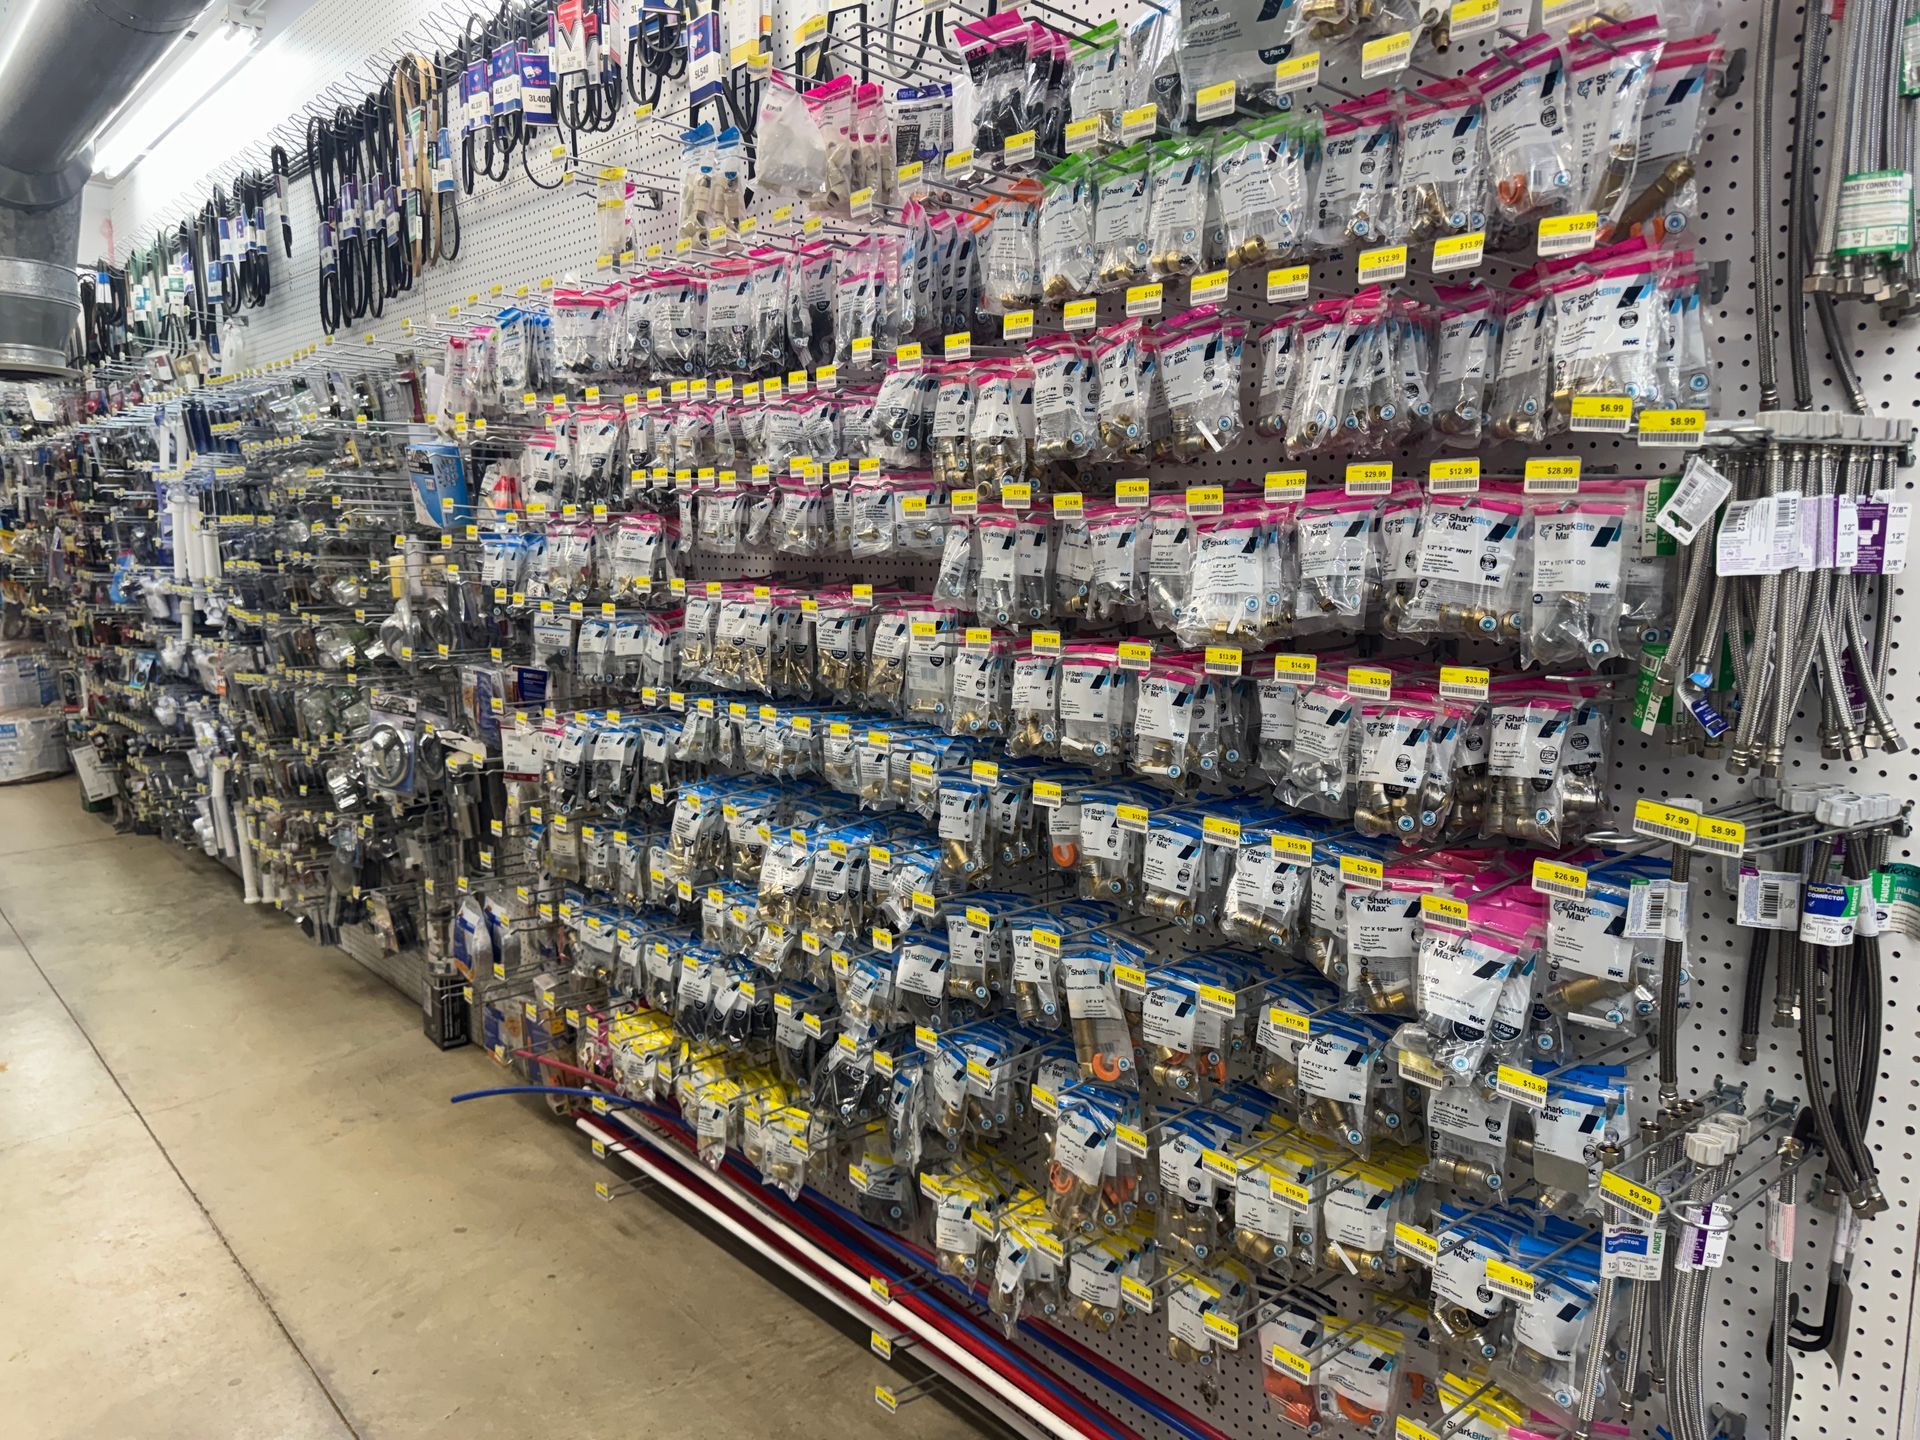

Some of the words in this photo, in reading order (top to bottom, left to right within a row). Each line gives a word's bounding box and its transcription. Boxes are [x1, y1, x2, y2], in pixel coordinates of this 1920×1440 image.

[1272, 48, 1285, 57] Pack
[529, 94, 549, 103] 3L400
[1569, 222, 1596, 231] $12.99
[1460, 240, 1483, 250] $13.99
[1377, 254, 1399, 263] $12.99
[1292, 273, 1308, 281] $9.99
[1144, 290, 1161, 298] $12.99
[1577, 287, 1621, 304] SharkBite
[1622, 338, 1639, 346] RWC
[1600, 403, 1624, 413] $6.99
[1670, 417, 1696, 426] $8.99
[1364, 470, 1386, 478] $29.99
[1646, 491, 1658, 523] FAUCET
[1789, 499, 1797, 525] B1T12
[1449, 513, 1491, 526] SharkBite
[1737, 506, 1749, 533] B1T12
[1448, 522, 1470, 531] Max
[1556, 523, 1595, 533] SharkBite
[1645, 528, 1656, 543] 12"
[1211, 539, 1243, 548] SharkBite
[1370, 677, 1391, 685] $33.99
[1465, 676, 1488, 684] $33.99
[1506, 714, 1543, 723] SharkBite
[1665, 813, 1689, 825] $7.99
[1221, 827, 1238, 835] $12.99
[1711, 825, 1736, 837] $8.99
[1357, 865, 1377, 874] $29.99
[1554, 872, 1579, 883] $26.99
[1881, 875, 1890, 901] FAUCET
[1368, 897, 1406, 905] SharkBite
[1808, 893, 1844, 901] CONNECTOR
[1850, 888, 1859, 915] FAUCET
[1367, 904, 1389, 912] Max
[1440, 903, 1461, 913] $46.99
[1568, 902, 1611, 918] SharkBite
[1566, 910, 1589, 922] Max
[1433, 949, 1460, 961] Max
[1608, 969, 1623, 977] RWC
[1286, 1018, 1303, 1027] $17.99
[1469, 1015, 1485, 1025] RWC
[1500, 1024, 1515, 1034] Pack
[1315, 1045, 1331, 1054] Max
[1317, 1039, 1348, 1052] SharkBite
[1523, 1080, 1546, 1093] $13.99
[1540, 1111, 1562, 1121] Max
[1285, 1187, 1303, 1198] $19.99
[1629, 1189, 1652, 1204] $9.99
[1416, 1238, 1436, 1250] $35.99
[1653, 1232, 1662, 1254] FAUCET
[1454, 1248, 1473, 1263] Max
[1511, 1276, 1534, 1289] $13.99
